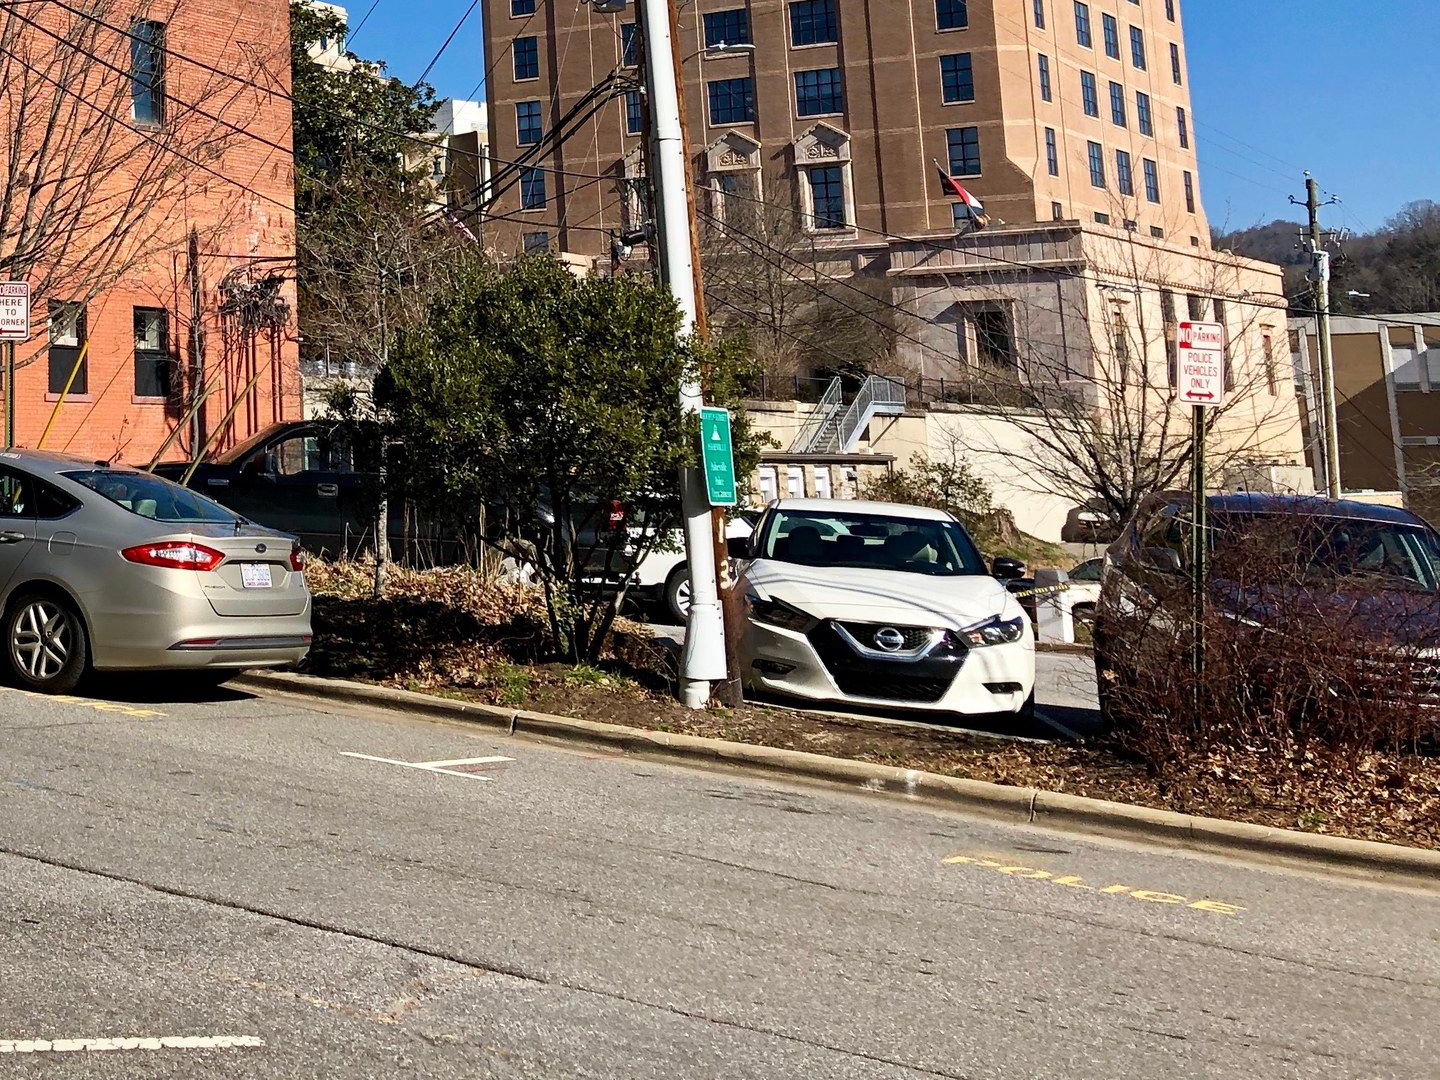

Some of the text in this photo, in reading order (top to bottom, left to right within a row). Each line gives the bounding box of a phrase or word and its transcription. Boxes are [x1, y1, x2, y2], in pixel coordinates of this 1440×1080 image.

[5, 285, 27, 296] PARKING
[5, 308, 17, 316] TO
[1179, 327, 1221, 344] NO PARKING
[1187, 352, 1213, 364] POLICE
[1183, 365, 1218, 377] VEHICLES
[1190, 378, 1211, 389] ONLY
